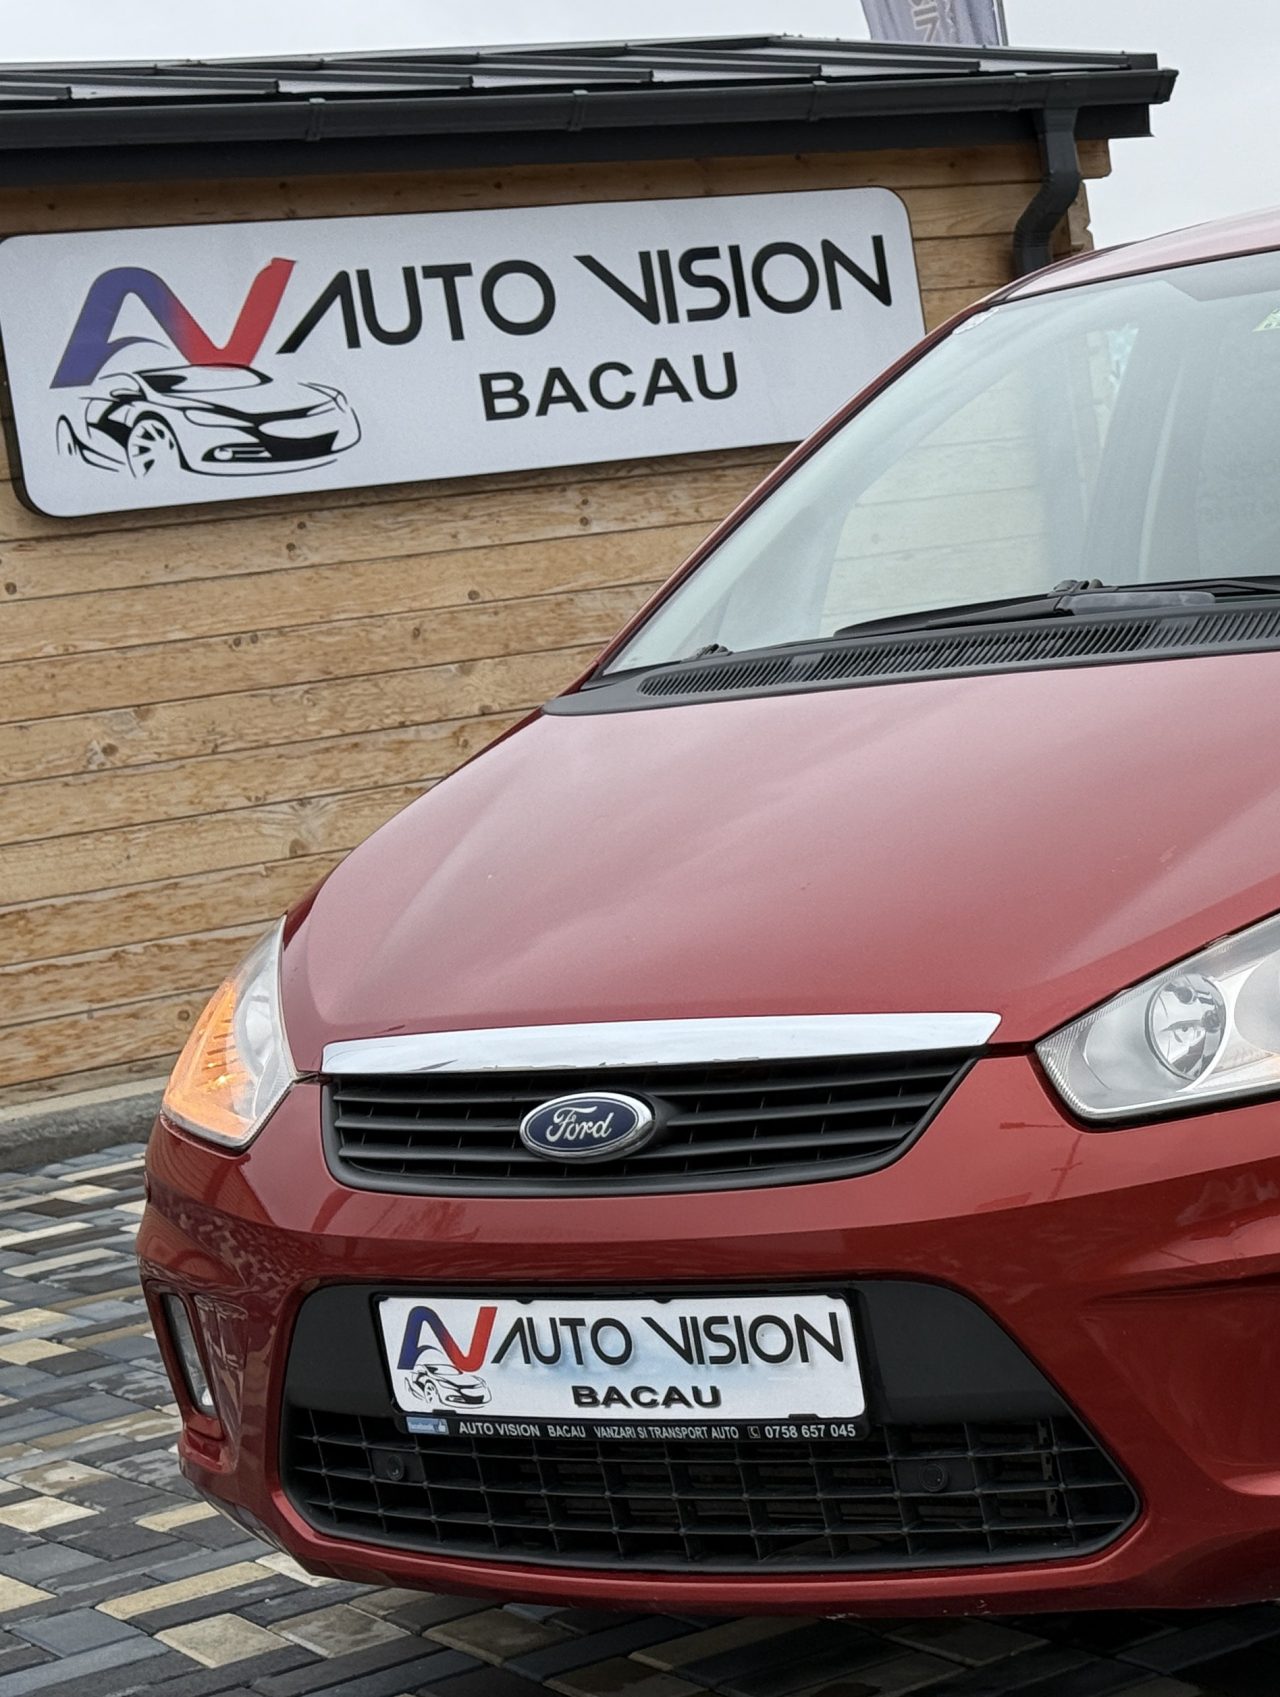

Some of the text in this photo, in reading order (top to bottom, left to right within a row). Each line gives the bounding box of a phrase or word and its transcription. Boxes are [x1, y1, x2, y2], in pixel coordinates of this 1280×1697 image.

[276, 235, 893, 354] AUTO VISION
[479, 351, 740, 421] BACAU
[545, 1106, 614, 1142] Ford
[491, 1311, 845, 1365] AUTO VISION
[573, 1385, 723, 1410] BACAU
[459, 1422, 856, 1439] AUTO VISION BACAU VANZARI SI TRANSPORT AUTO 0758 657 045
